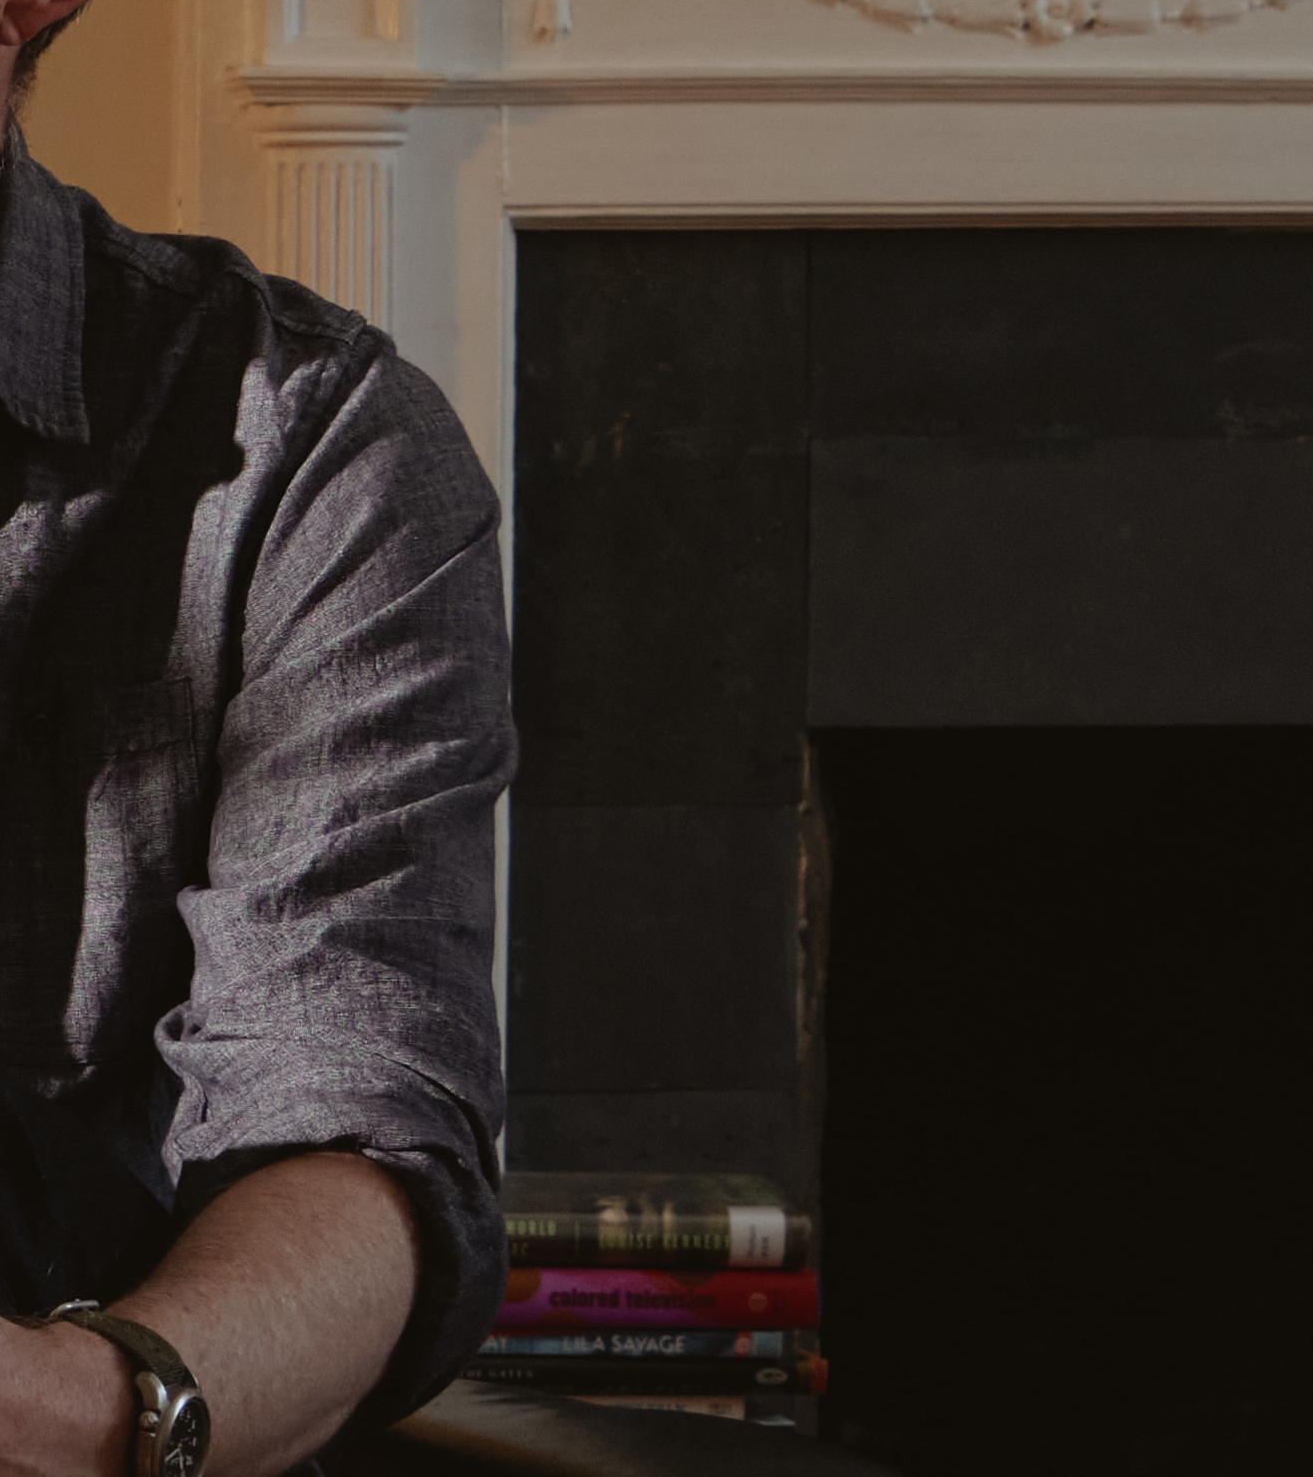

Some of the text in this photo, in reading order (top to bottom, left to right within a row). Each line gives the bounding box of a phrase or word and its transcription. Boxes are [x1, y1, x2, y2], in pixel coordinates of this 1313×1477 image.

[550, 1290, 620, 1308] colored
[562, 1336, 685, 1353] LILA SAVAGE
